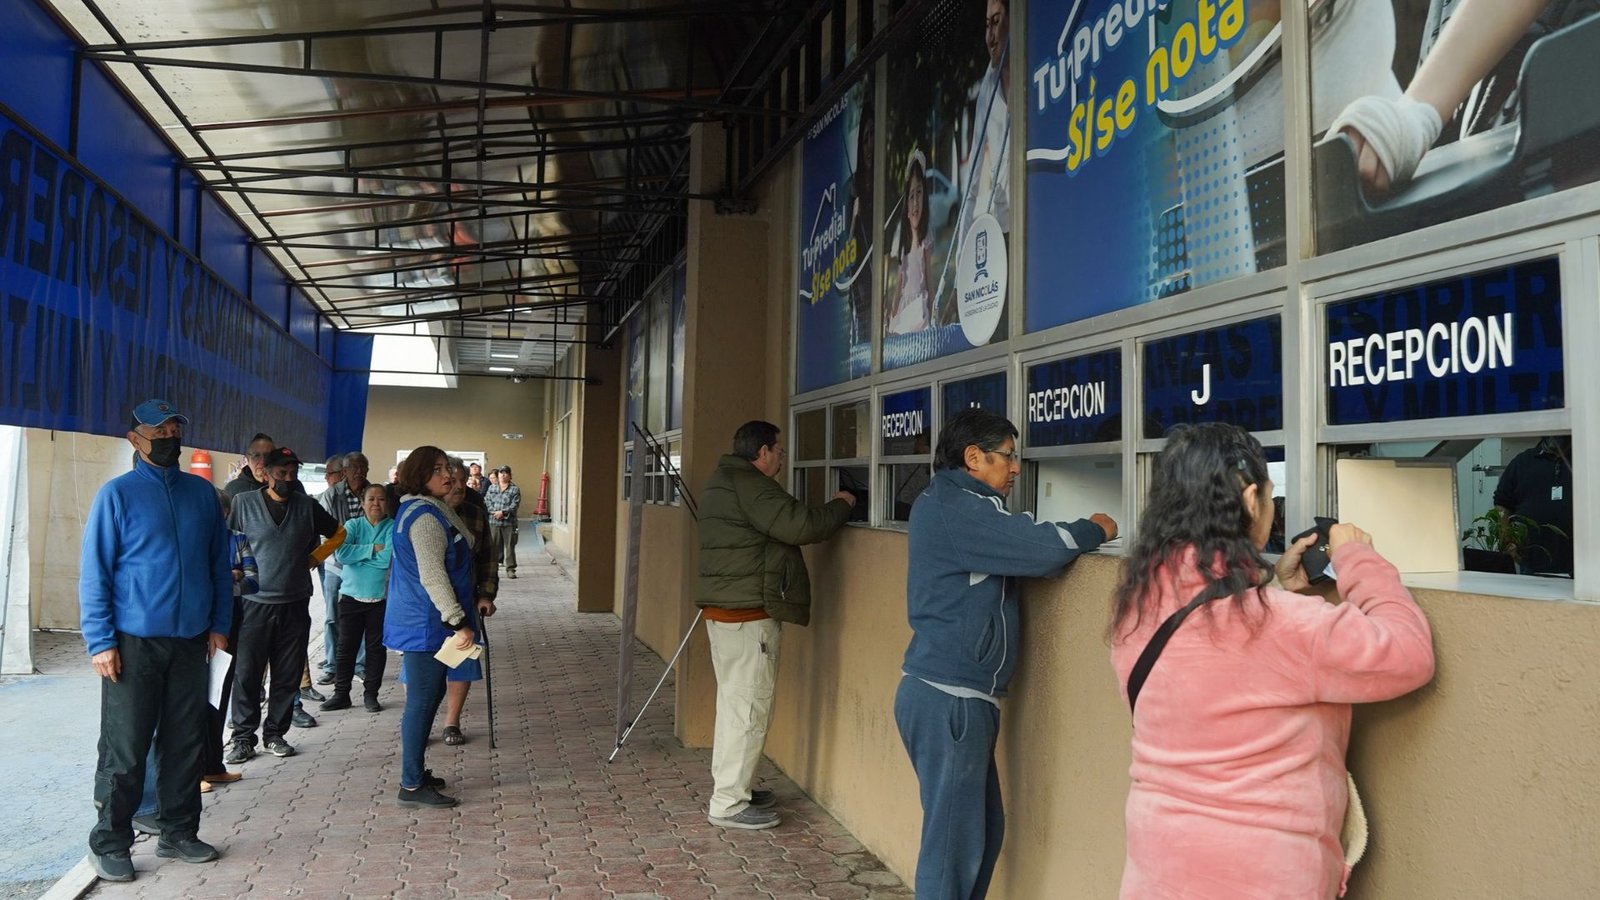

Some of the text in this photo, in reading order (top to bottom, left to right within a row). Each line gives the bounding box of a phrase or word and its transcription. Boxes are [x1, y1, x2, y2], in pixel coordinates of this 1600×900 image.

[1034, 0, 1166, 111] Tu Pre
[1096, 79, 1137, 150] se
[1146, 0, 1245, 105] nota
[802, 204, 846, 271] Tu Predial
[833, 238, 857, 283] nota
[964, 291, 975, 303] SAN
[1329, 312, 1514, 388] RECEPCION
[1028, 380, 1106, 423] RECEPCION
[1190, 363, 1211, 406] J
[882, 410, 923, 438] RECEPCION
